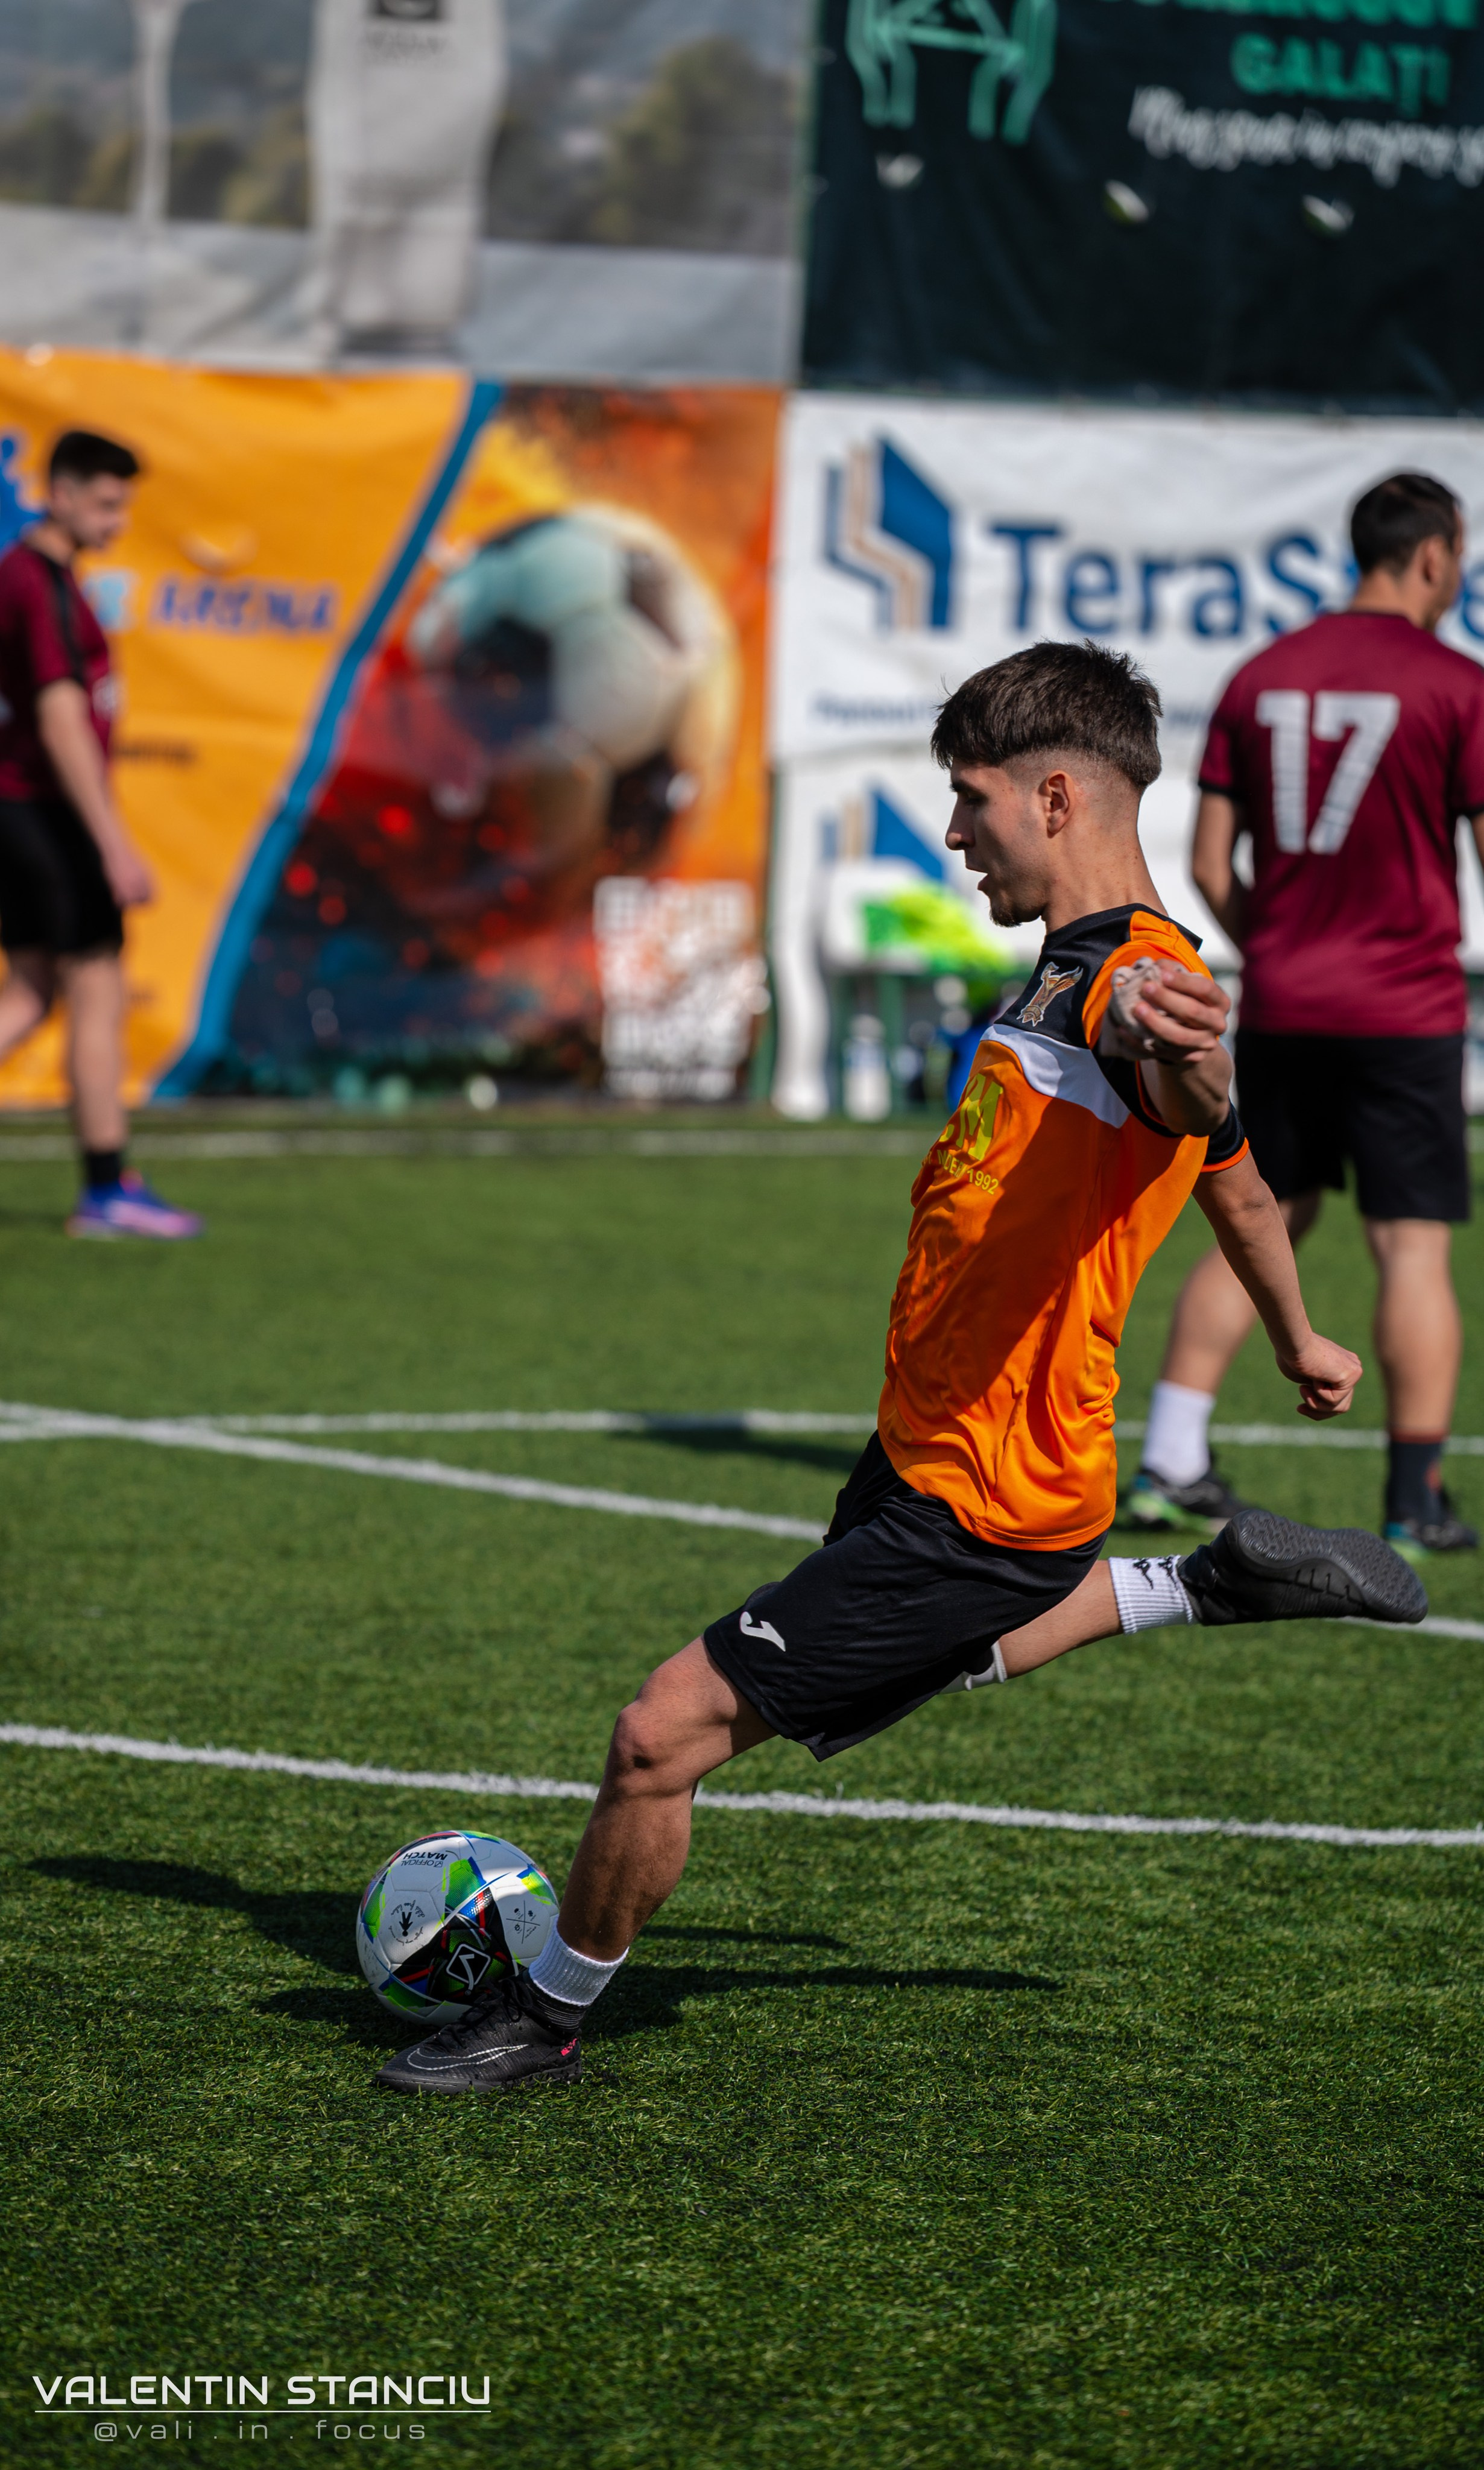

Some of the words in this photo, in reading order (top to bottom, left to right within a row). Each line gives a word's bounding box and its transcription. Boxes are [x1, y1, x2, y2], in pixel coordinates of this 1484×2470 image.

[1255, 689, 1400, 854] 17
[967, 1168, 999, 1195] 1992
[403, 1852, 448, 1861] MATCH
